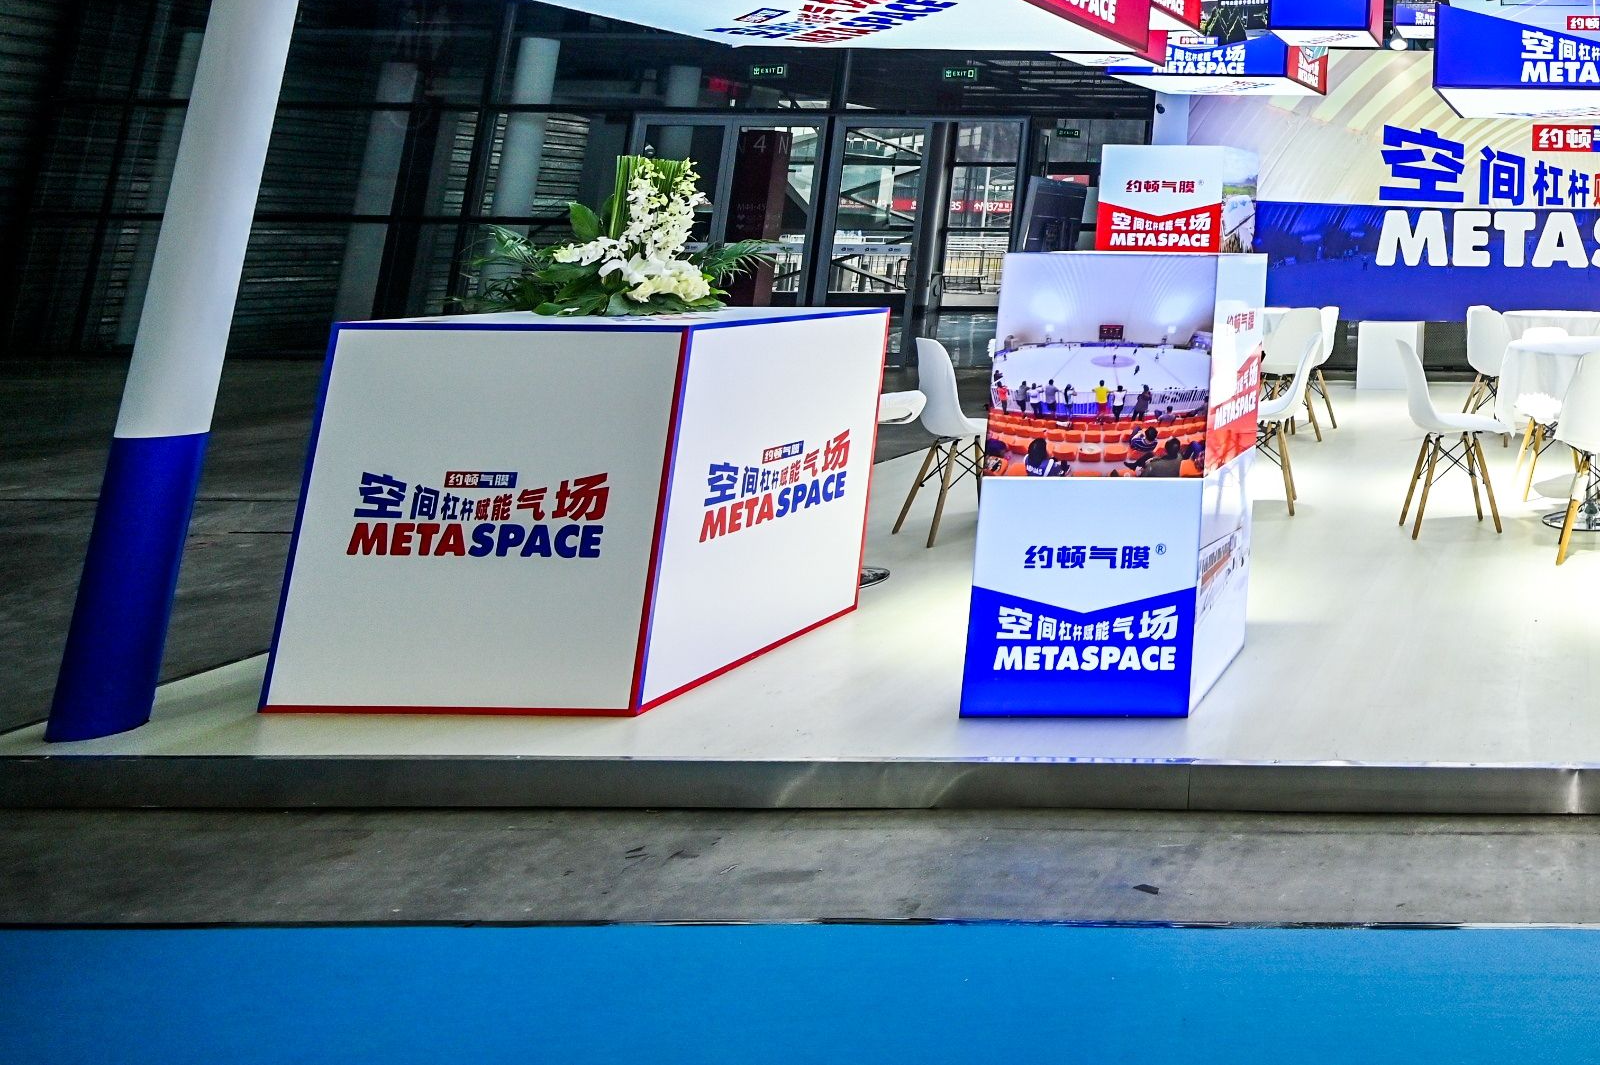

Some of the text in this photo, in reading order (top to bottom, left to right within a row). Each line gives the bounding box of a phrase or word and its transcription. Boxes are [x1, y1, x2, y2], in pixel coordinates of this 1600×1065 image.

[1109, 232, 1211, 248] METASPACE
[703, 428, 852, 508] 空间杠杆赋能气场
[353, 472, 610, 522] 空间杠杆赋能气场
[697, 471, 849, 544] METASPACE
[346, 522, 605, 559] METASPACE
[995, 604, 1179, 642] 空间杠杆赋能气场
[992, 645, 1178, 672] METASPACE
